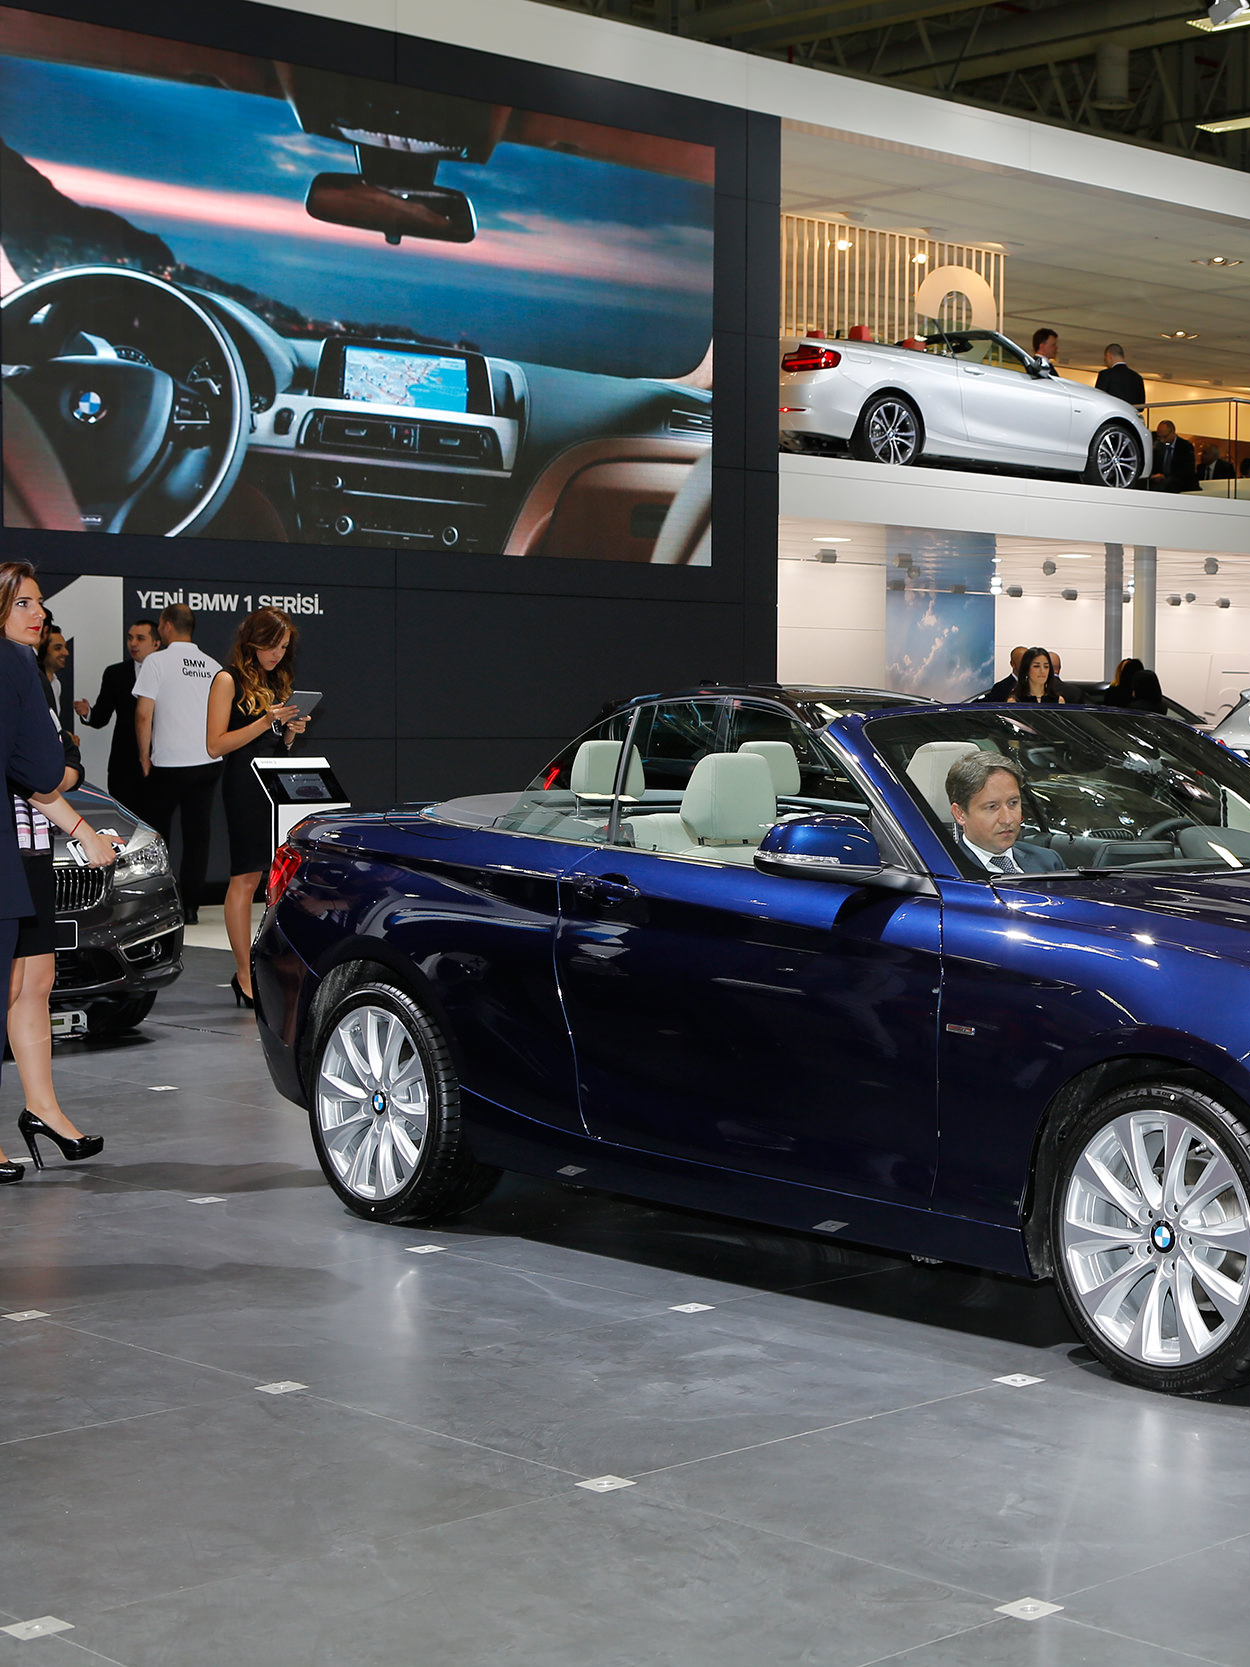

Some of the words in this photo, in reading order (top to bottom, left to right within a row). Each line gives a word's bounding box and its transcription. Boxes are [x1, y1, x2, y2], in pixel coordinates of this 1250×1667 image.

[188, 593, 239, 612] BMW
[243, 596, 252, 613] 1
[183, 658, 206, 668] BMW
[182, 667, 212, 678] Genius
